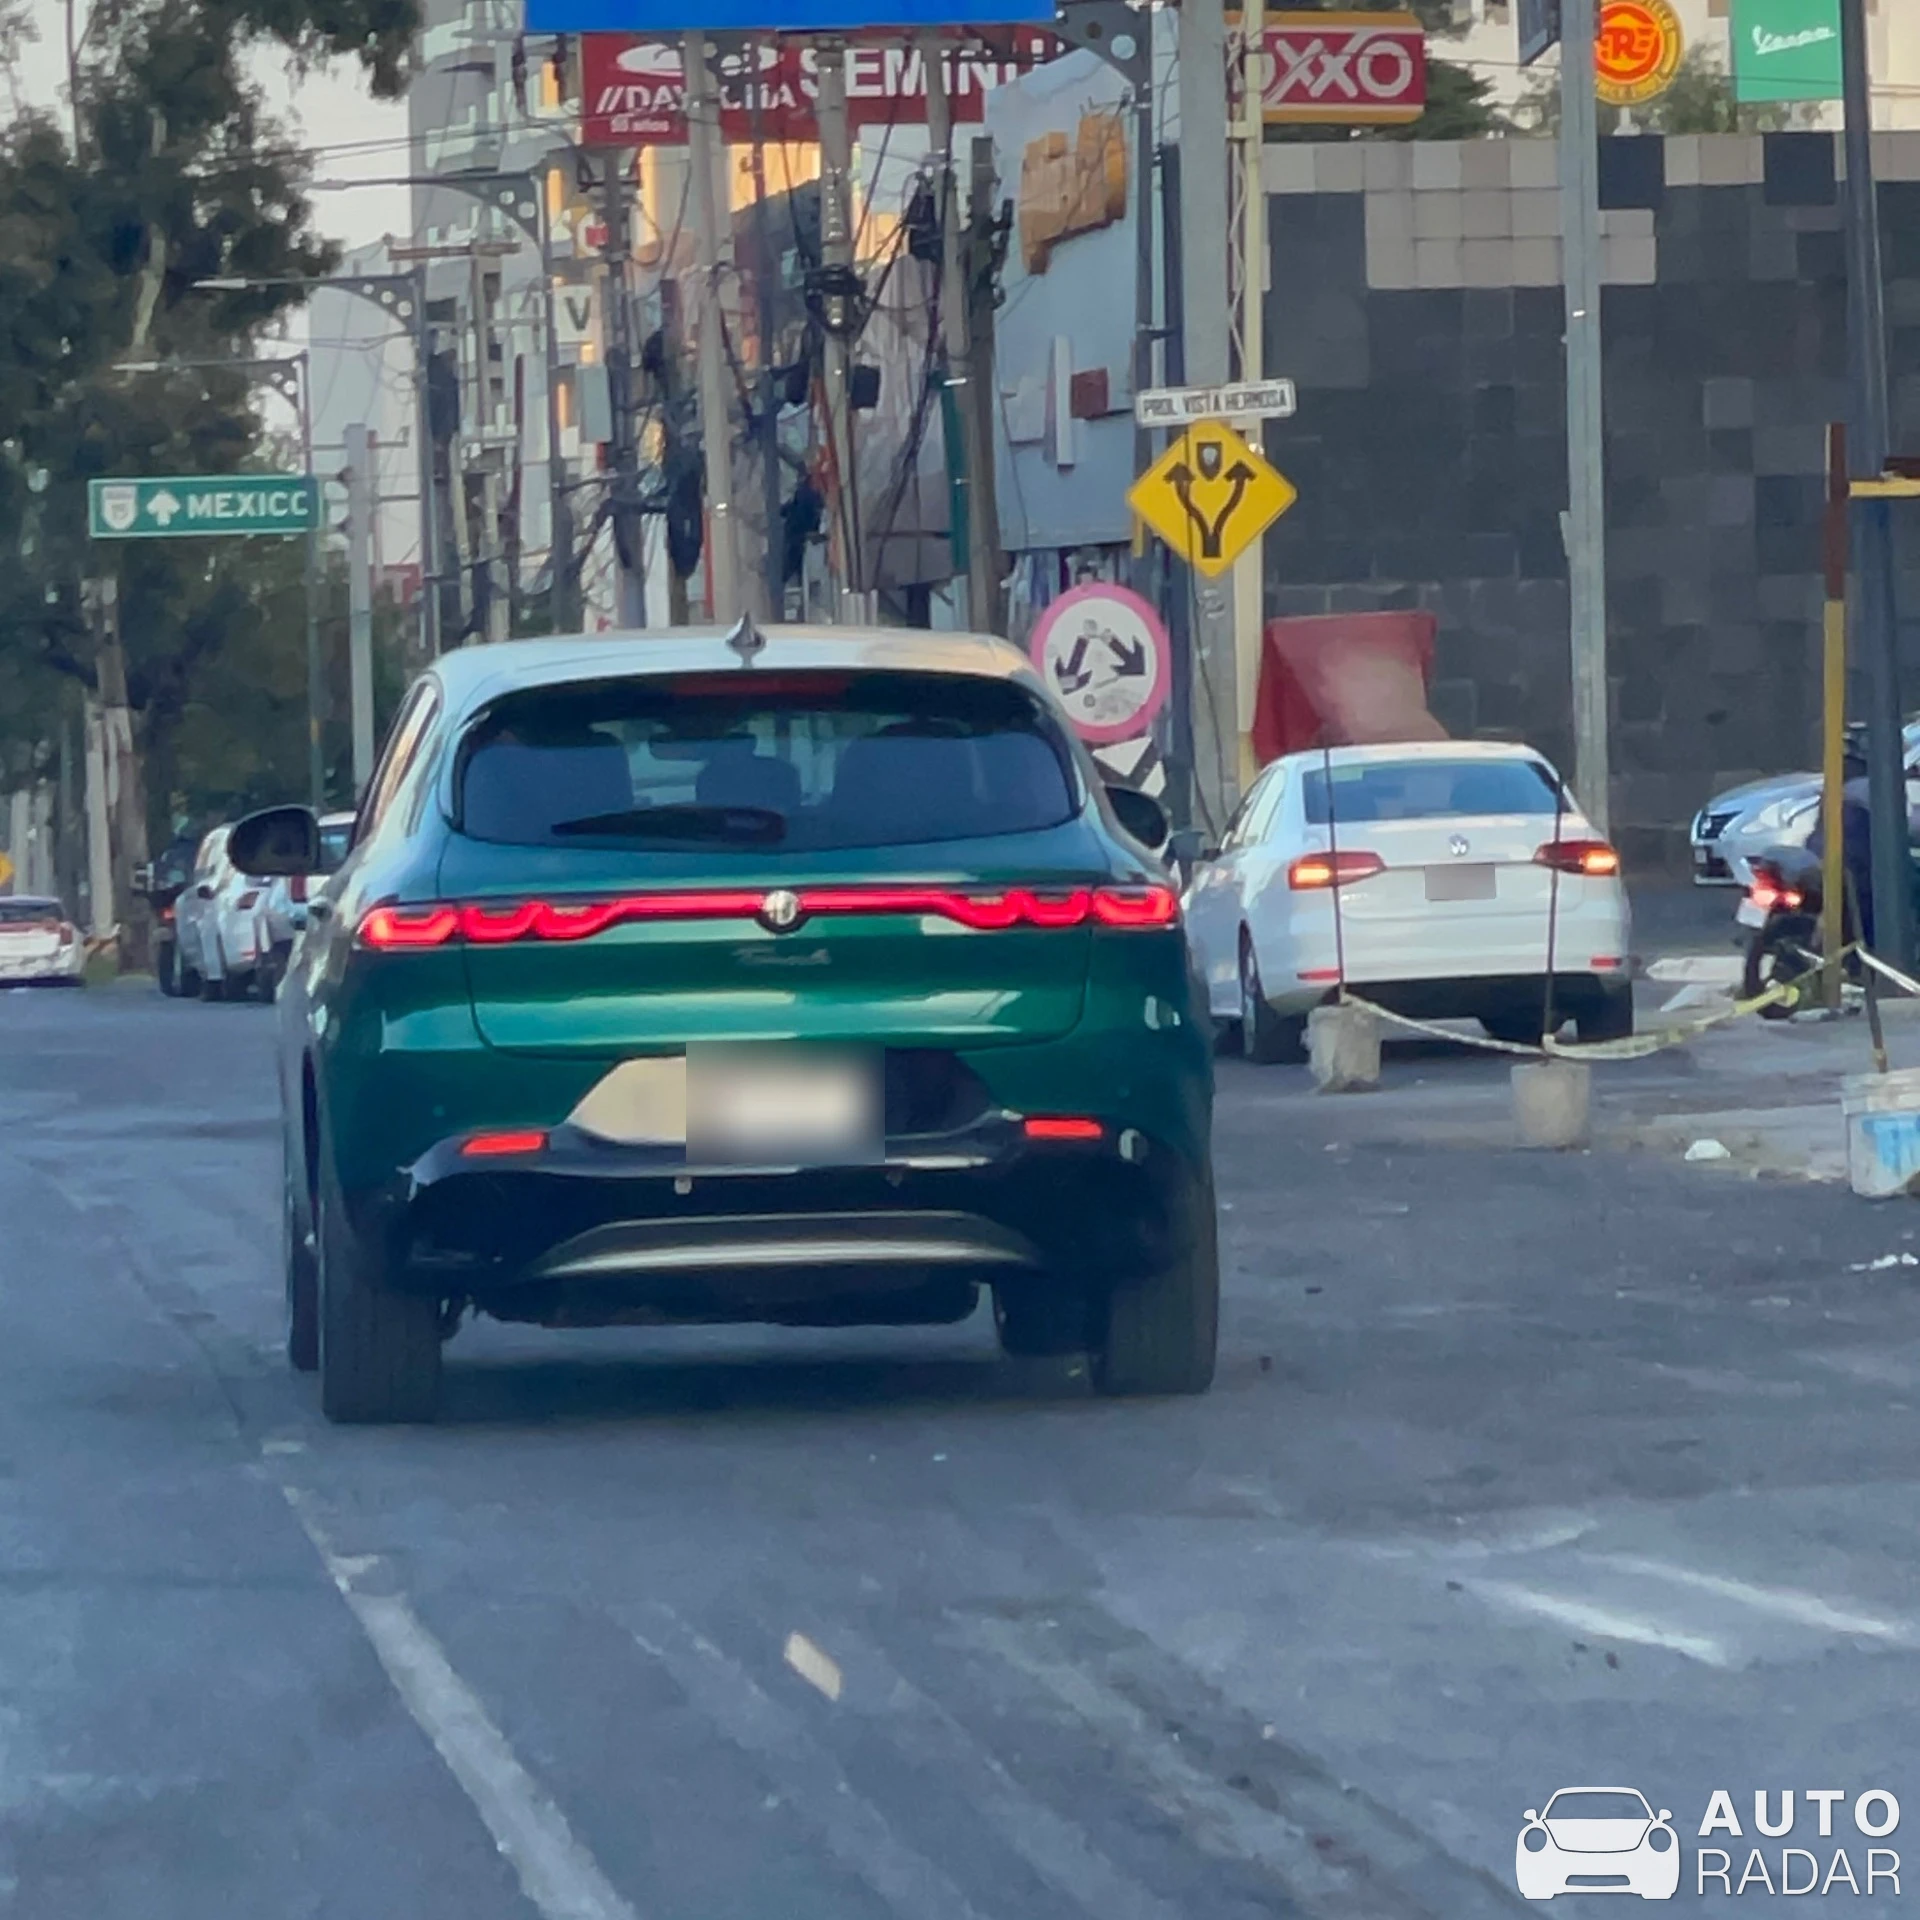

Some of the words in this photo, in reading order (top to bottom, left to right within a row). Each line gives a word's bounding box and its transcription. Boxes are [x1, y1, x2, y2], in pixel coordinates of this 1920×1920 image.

[799, 38, 1064, 97] SEMINU
[563, 296, 592, 332] V
[1182, 393, 1222, 414] VISTA
